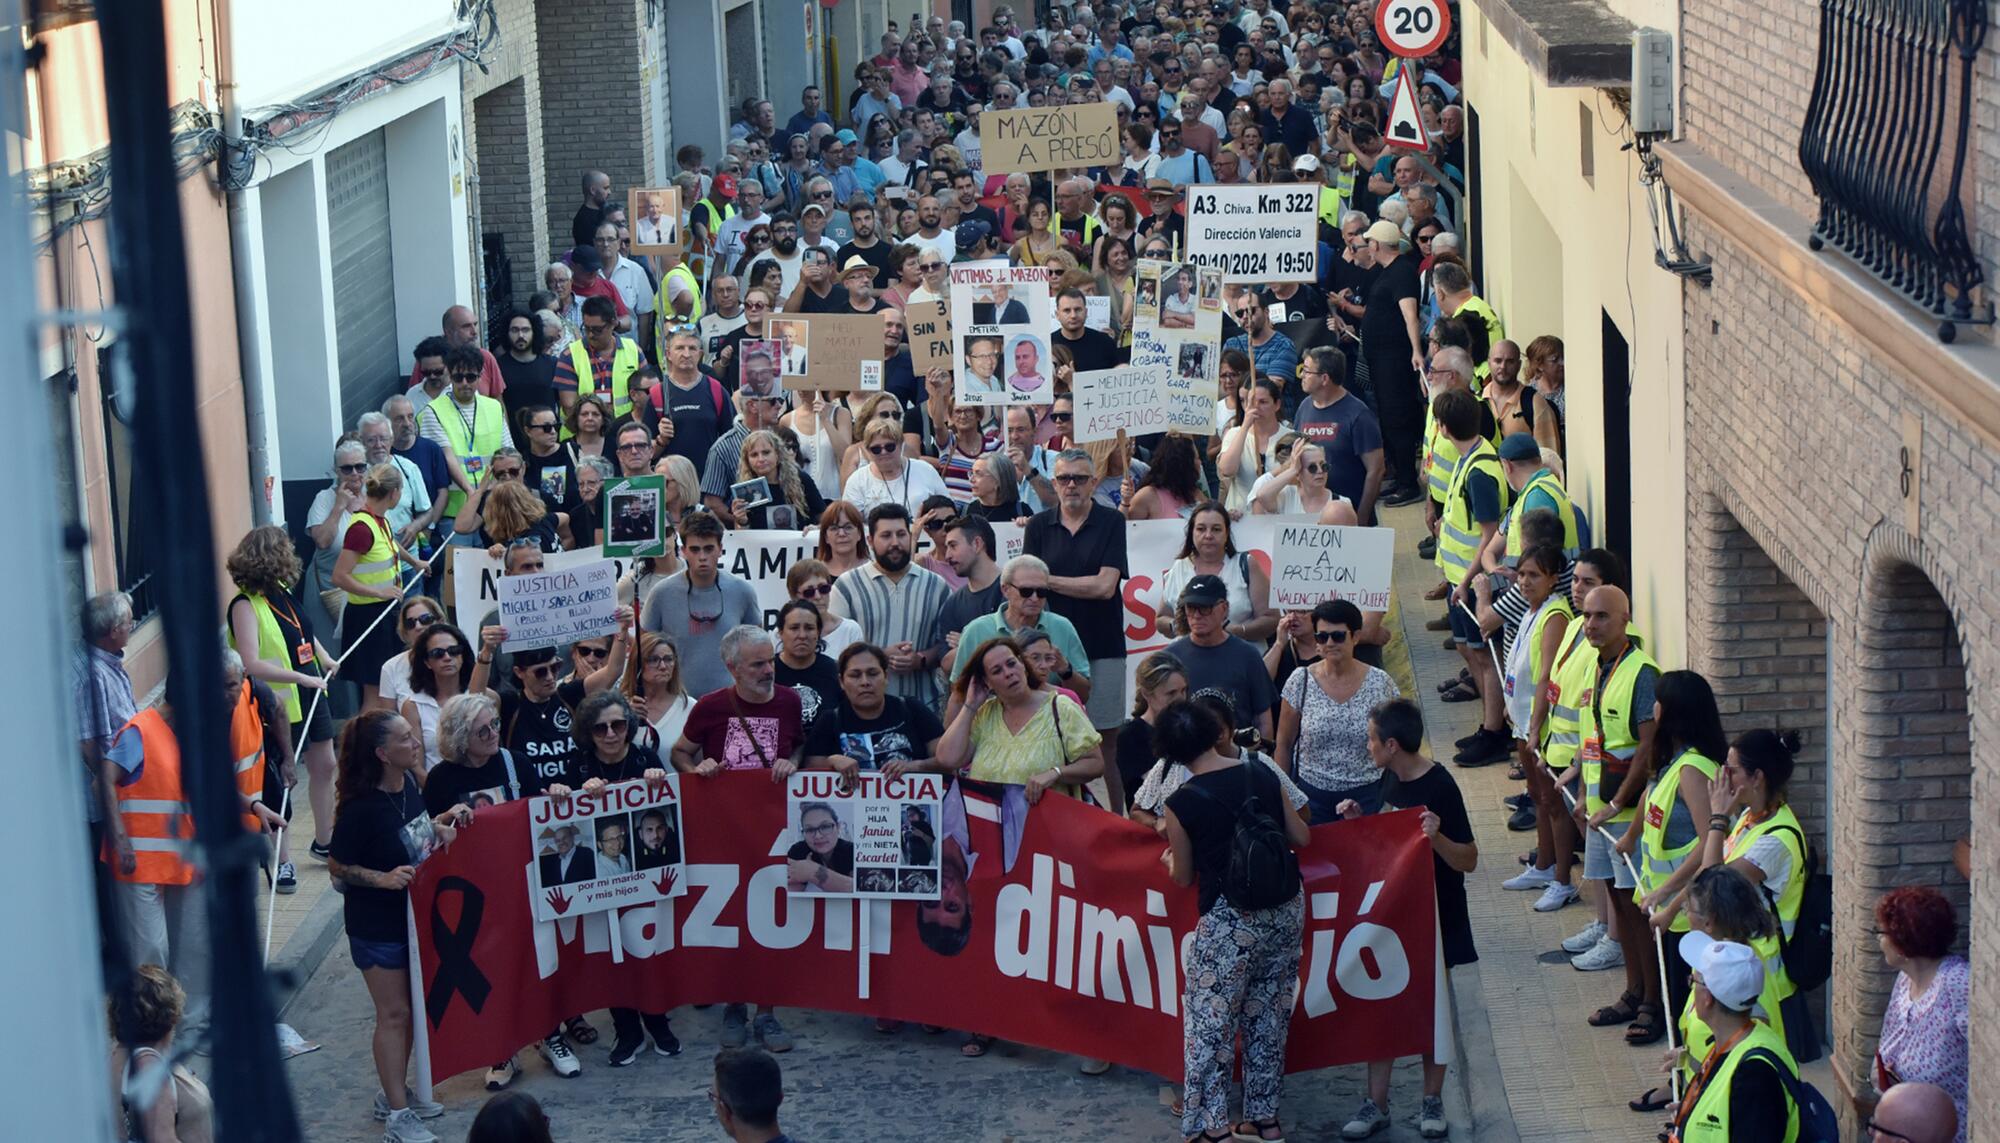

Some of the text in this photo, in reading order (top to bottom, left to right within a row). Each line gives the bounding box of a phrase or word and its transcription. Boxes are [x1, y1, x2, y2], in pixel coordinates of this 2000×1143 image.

[1394, 6, 1433, 34] 20
[998, 108, 1077, 139] MAZÓN
[1017, 126, 1112, 164] A PRESÓ
[1193, 193, 1313, 214] A3. Chiva. Km 322
[1204, 226, 1301, 240] Dirección Valencia
[1276, 251, 1314, 274] 19:50
[936, 300, 947, 316] 3
[913, 322, 936, 336] SIN
[1098, 370, 1157, 390] MENTIRAS
[1098, 389, 1159, 409] JUSTICIA
[1088, 407, 1165, 434] ASESINOS
[1281, 528, 1342, 548] MAZON
[1316, 550, 1330, 566] A
[513, 573, 579, 594] JUSTICIA
[587, 569, 608, 582] PARA
[502, 599, 539, 615] MIGUEL
[548, 594, 575, 610] SARA
[551, 623, 569, 635] LAS
[525, 736, 579, 757] SARA
[792, 776, 938, 800] JUSTICIA
[535, 779, 676, 824] JUSTICIA
[865, 805, 879, 813] por
[868, 815, 888, 823] HIJA
[860, 825, 896, 839] Janine
[873, 841, 899, 849] NIETA
[855, 851, 898, 863] Escarlett
[578, 871, 646, 893] por mi marido
[587, 885, 639, 903] y mis hijos
